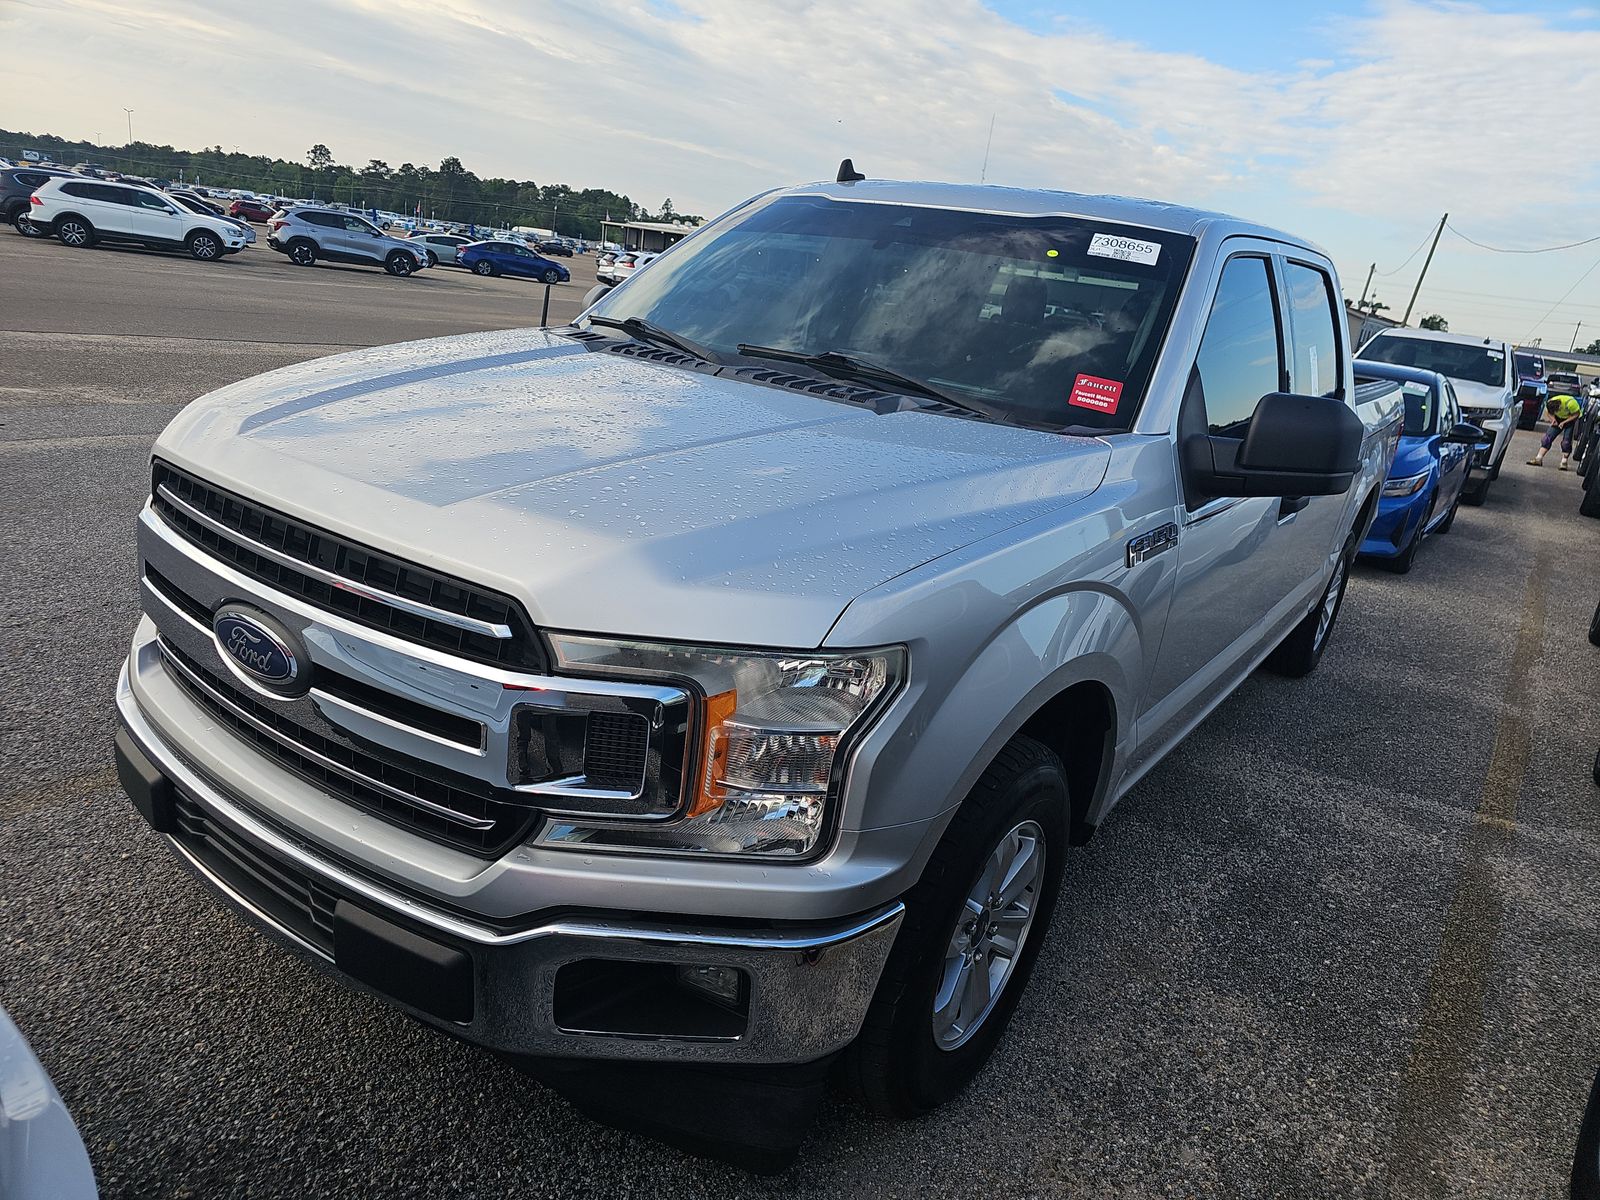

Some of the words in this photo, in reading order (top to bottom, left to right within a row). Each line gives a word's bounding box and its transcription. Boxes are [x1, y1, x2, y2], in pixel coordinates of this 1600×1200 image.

[1094, 236, 1153, 254] 7308655
[1077, 378, 1117, 393] Faucett
[1075, 389, 1096, 399] Faucett
[1095, 394, 1115, 403] Motors
[227, 625, 273, 672] Ford
